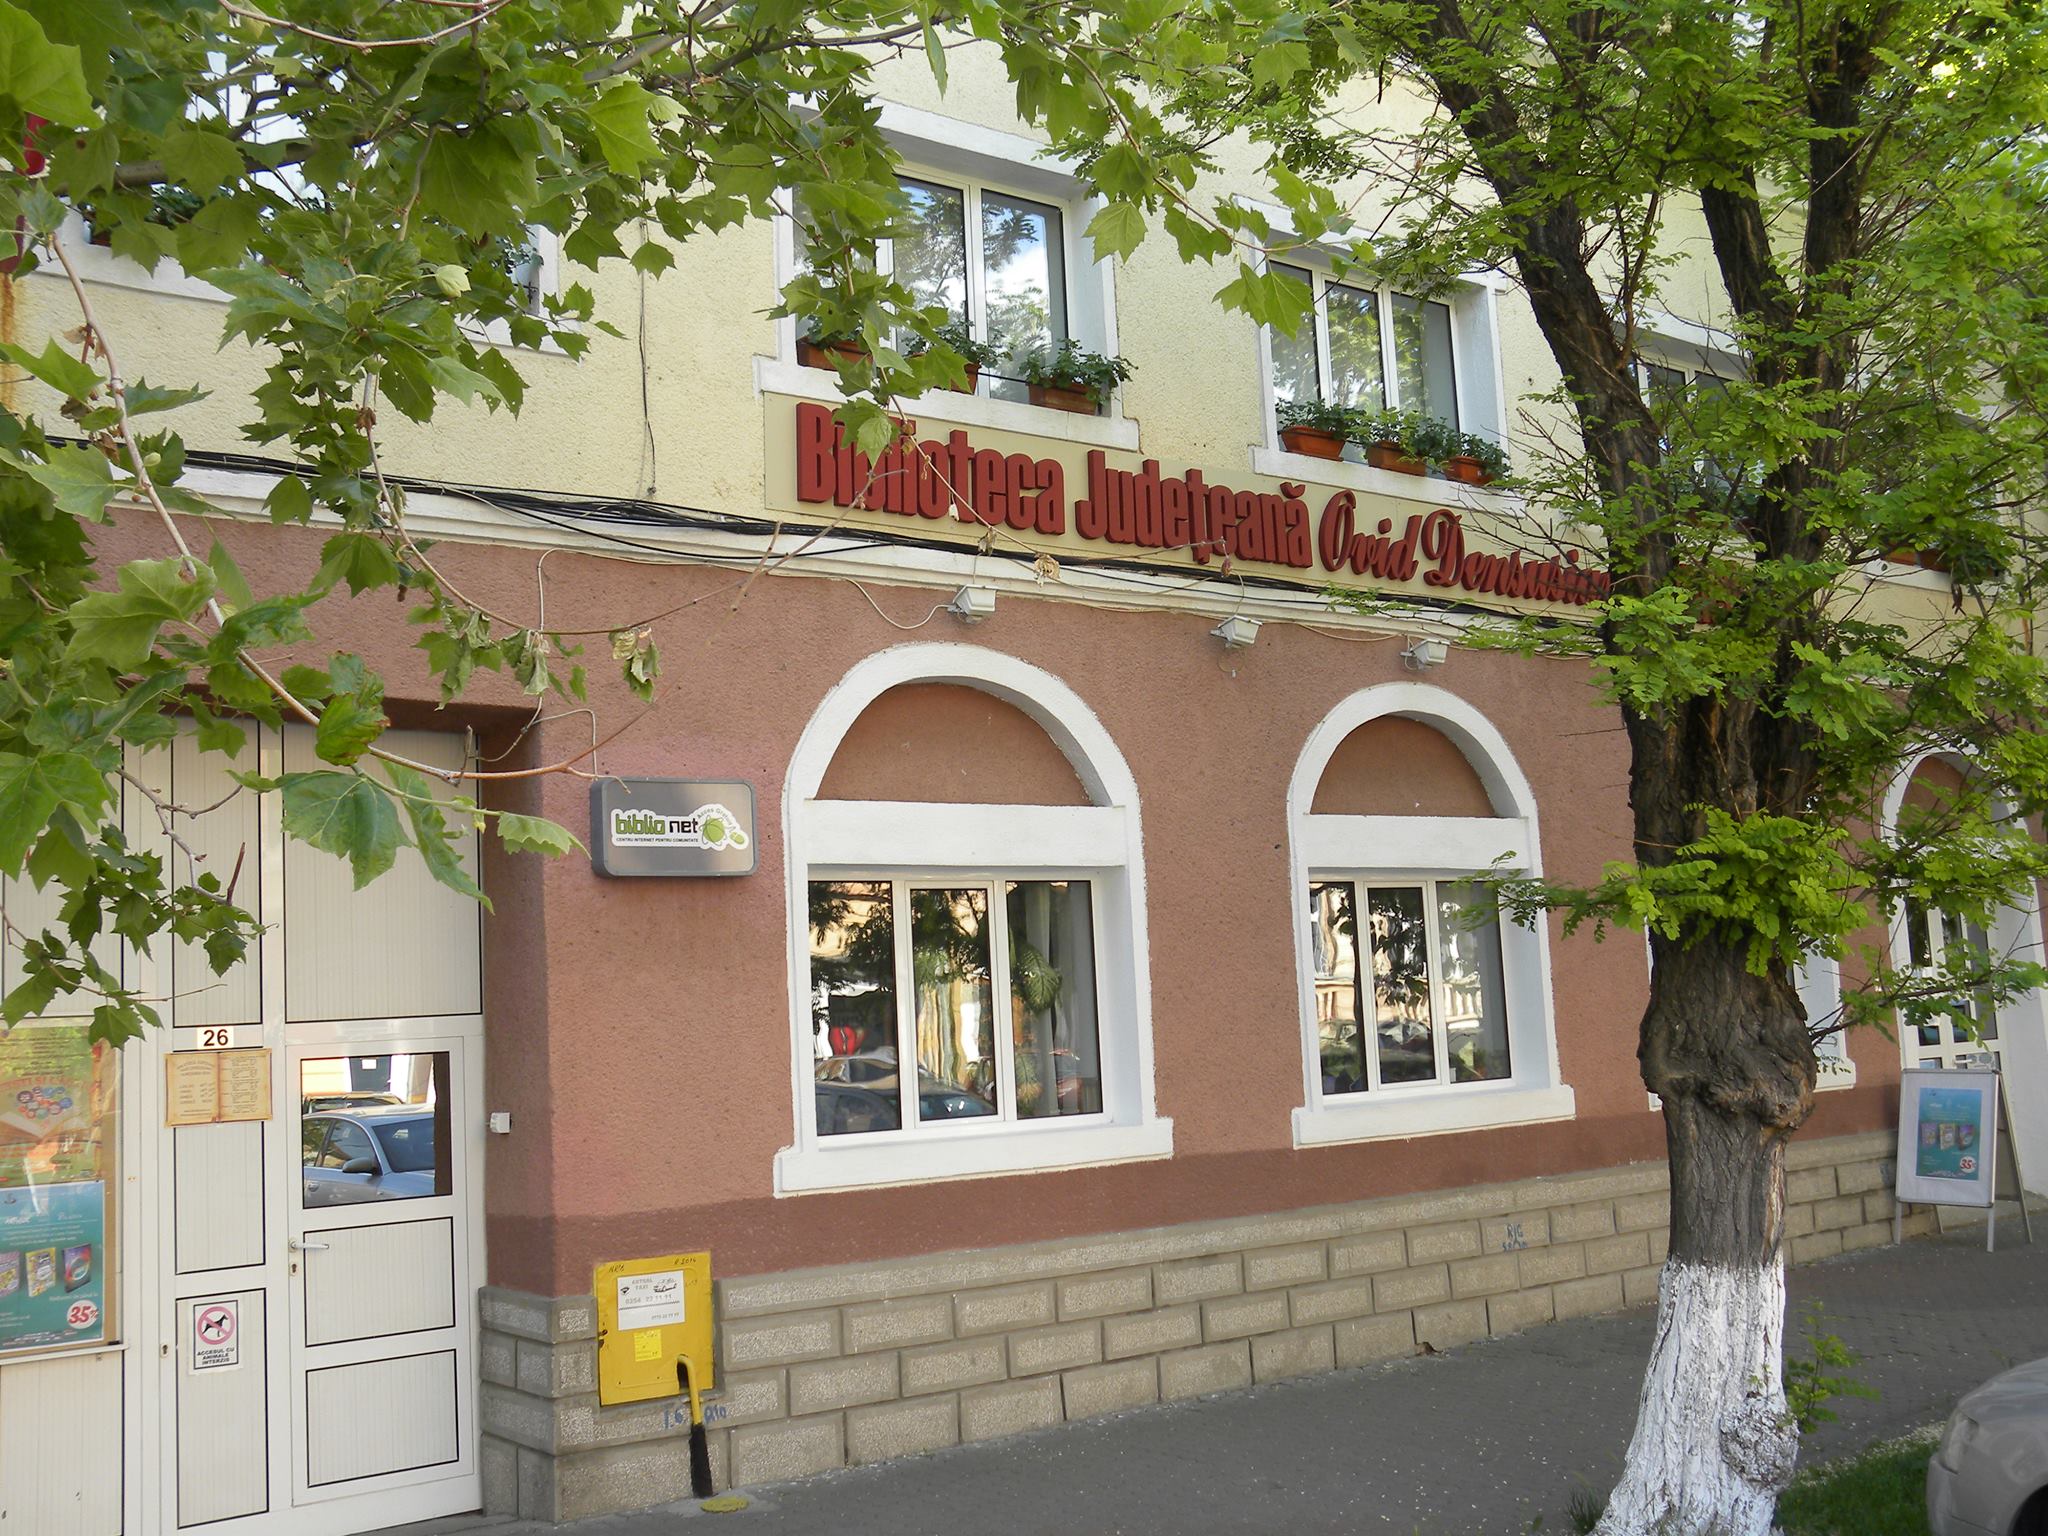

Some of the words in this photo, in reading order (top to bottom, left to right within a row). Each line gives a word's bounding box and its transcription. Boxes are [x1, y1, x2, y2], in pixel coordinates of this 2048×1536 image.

[1318, 490, 1422, 582] Ovid
[615, 813, 666, 835] biblio
[669, 818, 699, 834] net
[203, 1029, 229, 1046] 26
